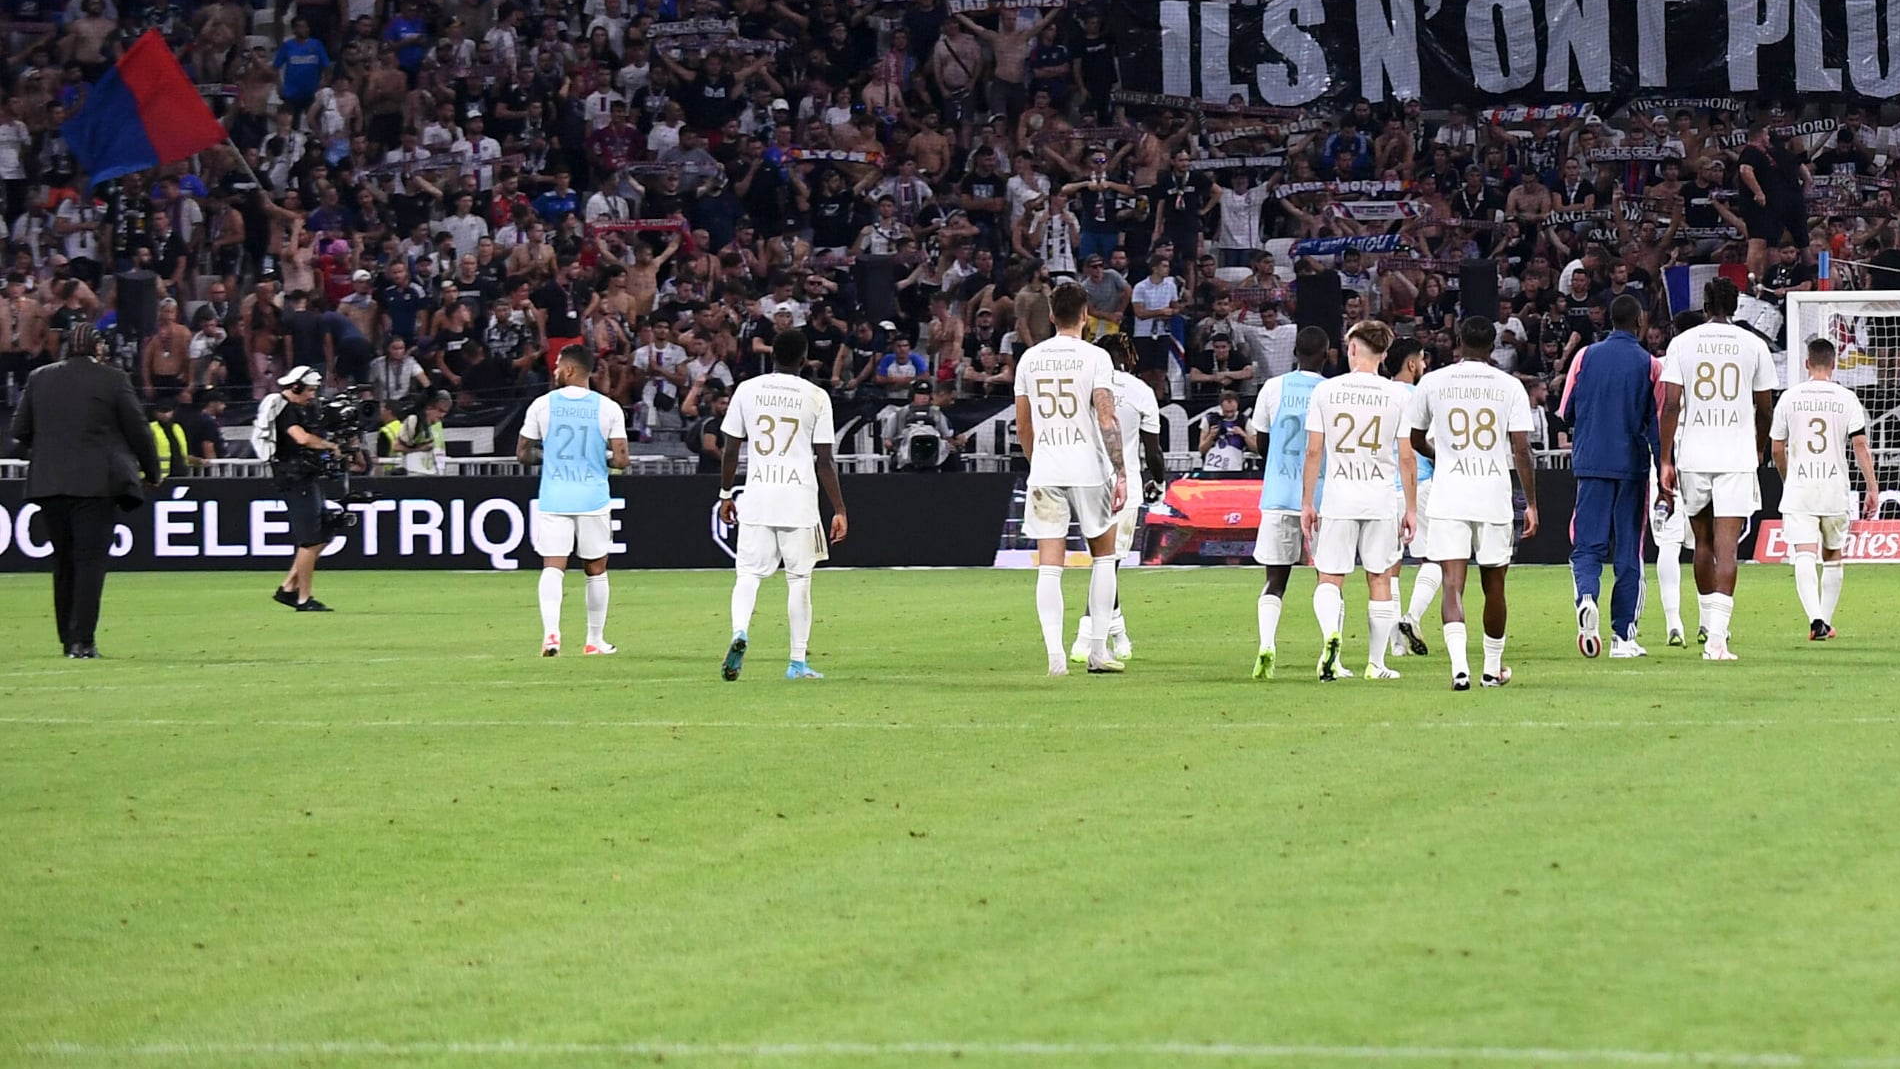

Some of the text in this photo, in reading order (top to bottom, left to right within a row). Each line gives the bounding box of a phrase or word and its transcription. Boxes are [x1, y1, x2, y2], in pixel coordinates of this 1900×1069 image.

[1634, 98, 1682, 112] VIRAGE
[1790, 117, 1835, 135] NORD
[1722, 133, 1748, 148] VIR
[1696, 342, 1740, 356] ALVERO
[1438, 385, 1505, 403] MAITLAND-NILES
[1693, 361, 1741, 402] 80
[755, 395, 803, 412] NUAMAH
[1035, 378, 1078, 419] 55
[1329, 392, 1389, 408] LEPENANT
[1792, 399, 1844, 415] TAGLIAFICO
[554, 424, 591, 461] 21
[754, 413, 800, 457] 37
[1279, 414, 1301, 457] 2
[1334, 412, 1381, 456] 24
[1447, 407, 1497, 452] 98
[1806, 417, 1828, 455] 3
